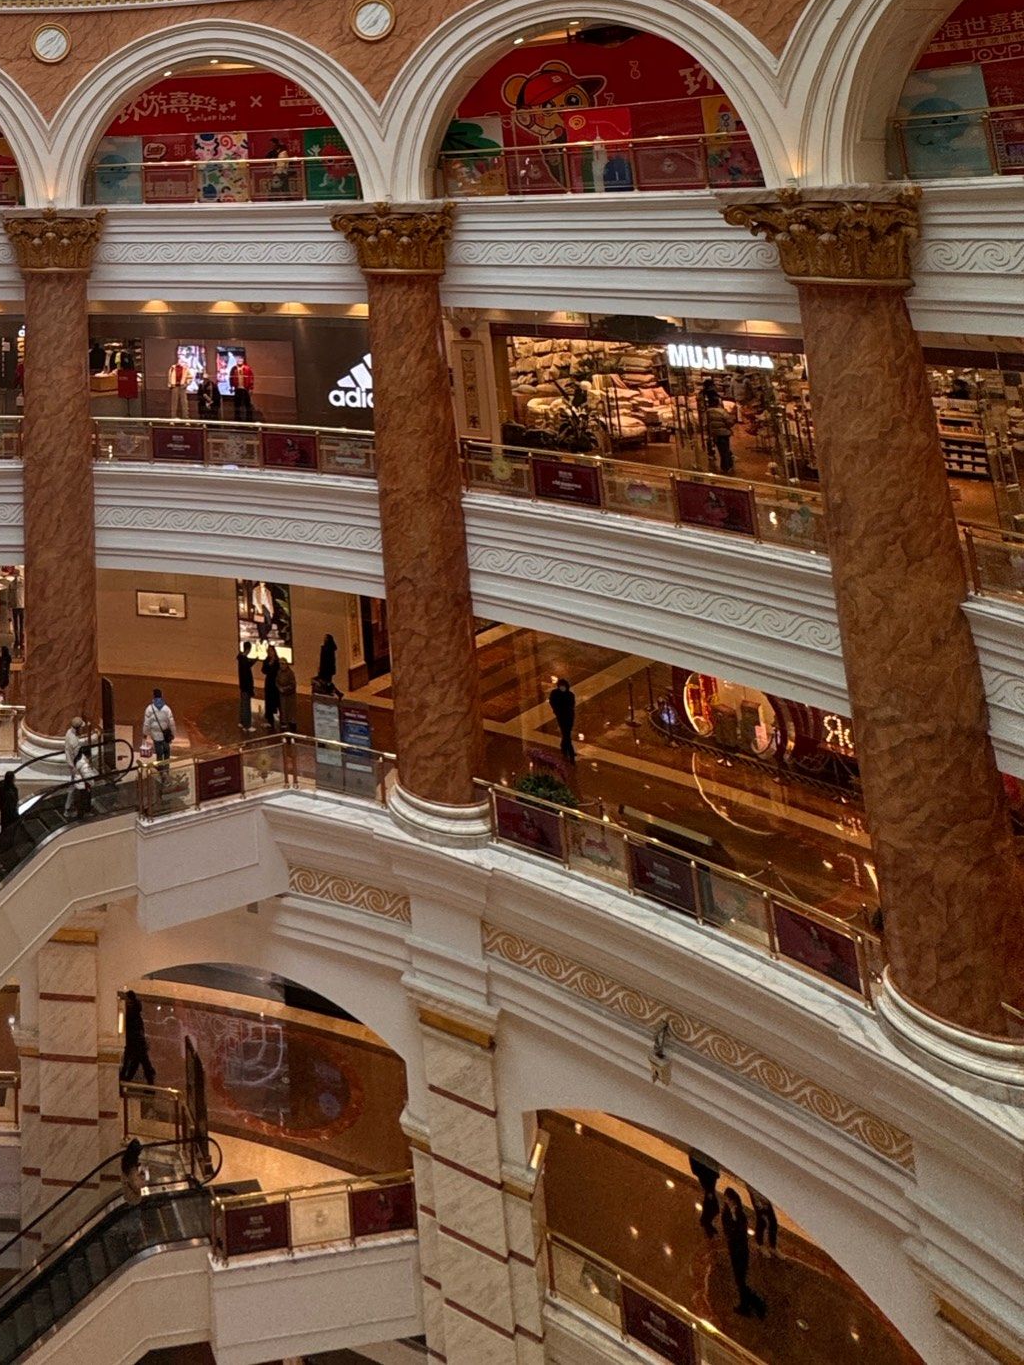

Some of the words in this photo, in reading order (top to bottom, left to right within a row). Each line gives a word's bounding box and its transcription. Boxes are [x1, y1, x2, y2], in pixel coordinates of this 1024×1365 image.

[932, 10, 1024, 41] 海世嘉都
[667, 344, 724, 370] MUJI
[328, 386, 374, 408] adi
